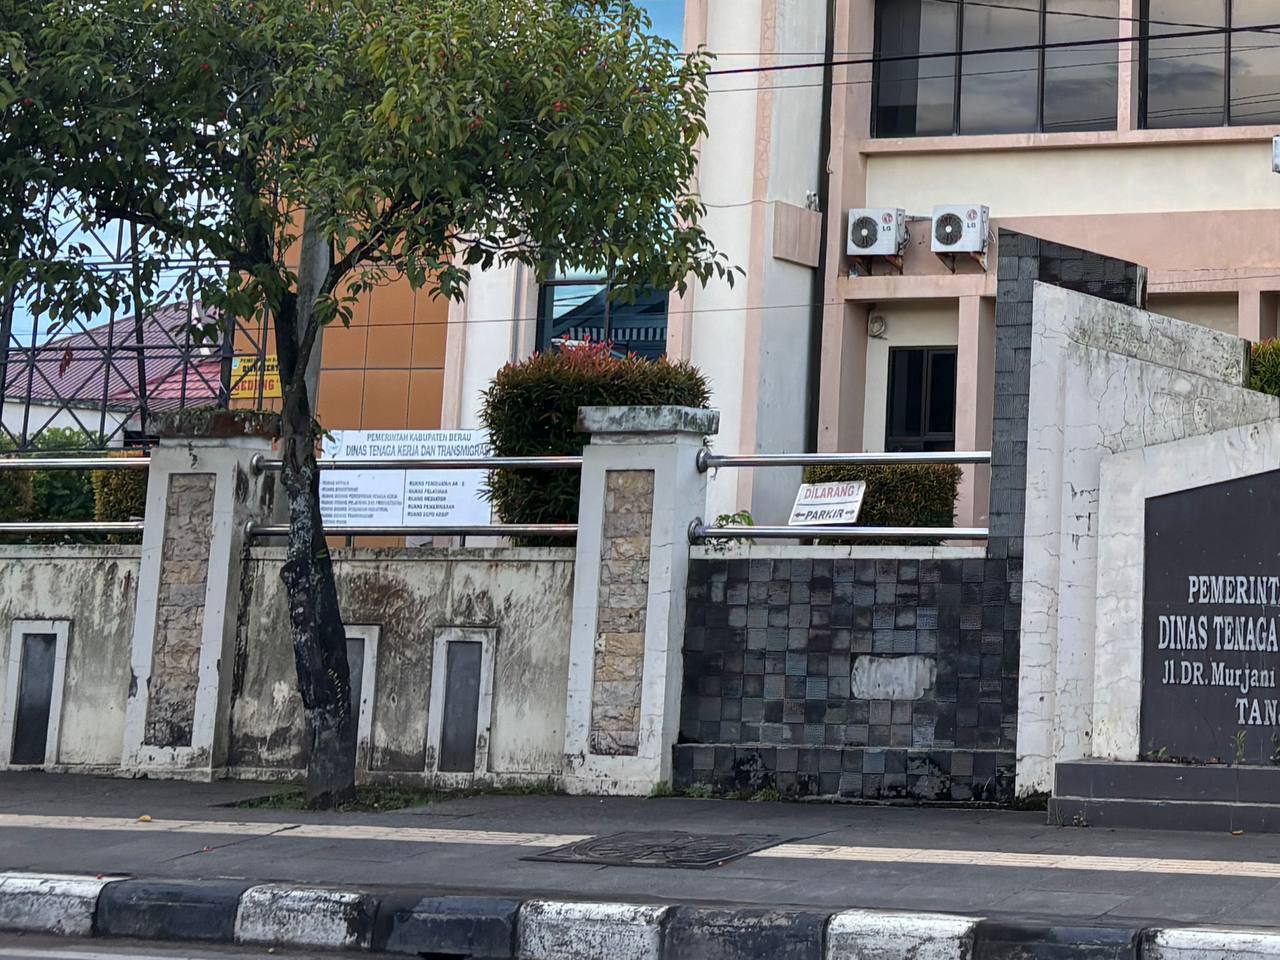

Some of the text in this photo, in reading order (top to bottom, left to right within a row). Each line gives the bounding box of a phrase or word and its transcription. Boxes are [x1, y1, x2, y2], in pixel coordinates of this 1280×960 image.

[409, 432, 447, 442] KABUPATEN
[346, 444, 368, 456] DINAS
[369, 444, 396, 456] TENAGA
[397, 444, 420, 456] KERJA
[421, 444, 437, 456] DAN
[805, 509, 844, 520] PARKIR
[1158, 615, 1208, 650] DINAS
[1213, 615, 1279, 652] TENAGA
